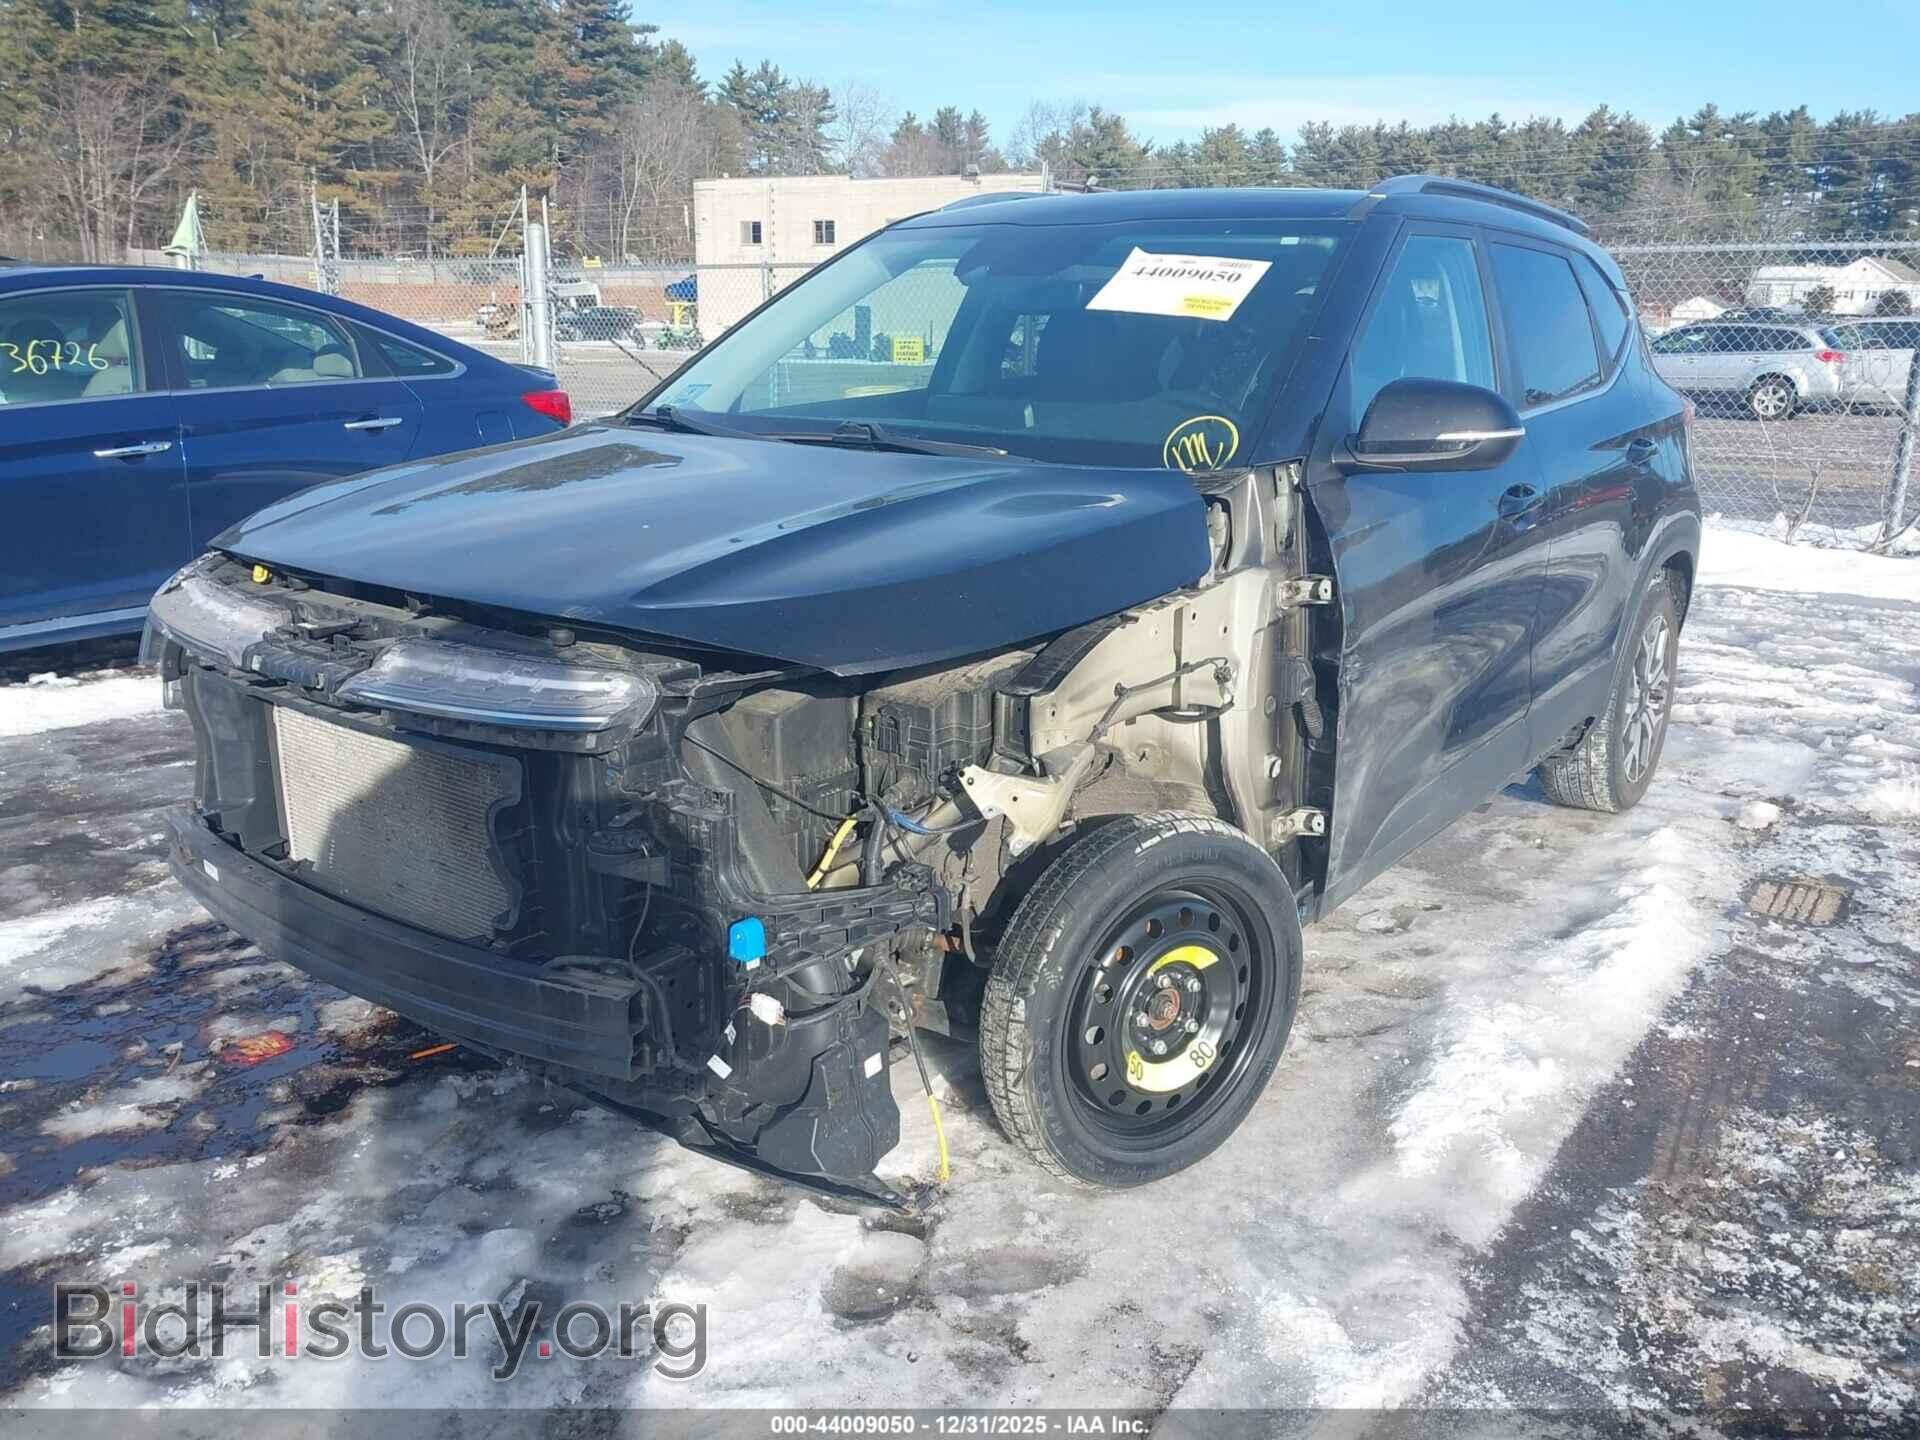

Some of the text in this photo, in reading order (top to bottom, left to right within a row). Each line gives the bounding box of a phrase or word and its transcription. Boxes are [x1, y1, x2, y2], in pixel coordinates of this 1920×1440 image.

[1131, 266, 1243, 283] 44009050
[0, 339, 109, 375] 36726
[1189, 1041, 1215, 1069] 80
